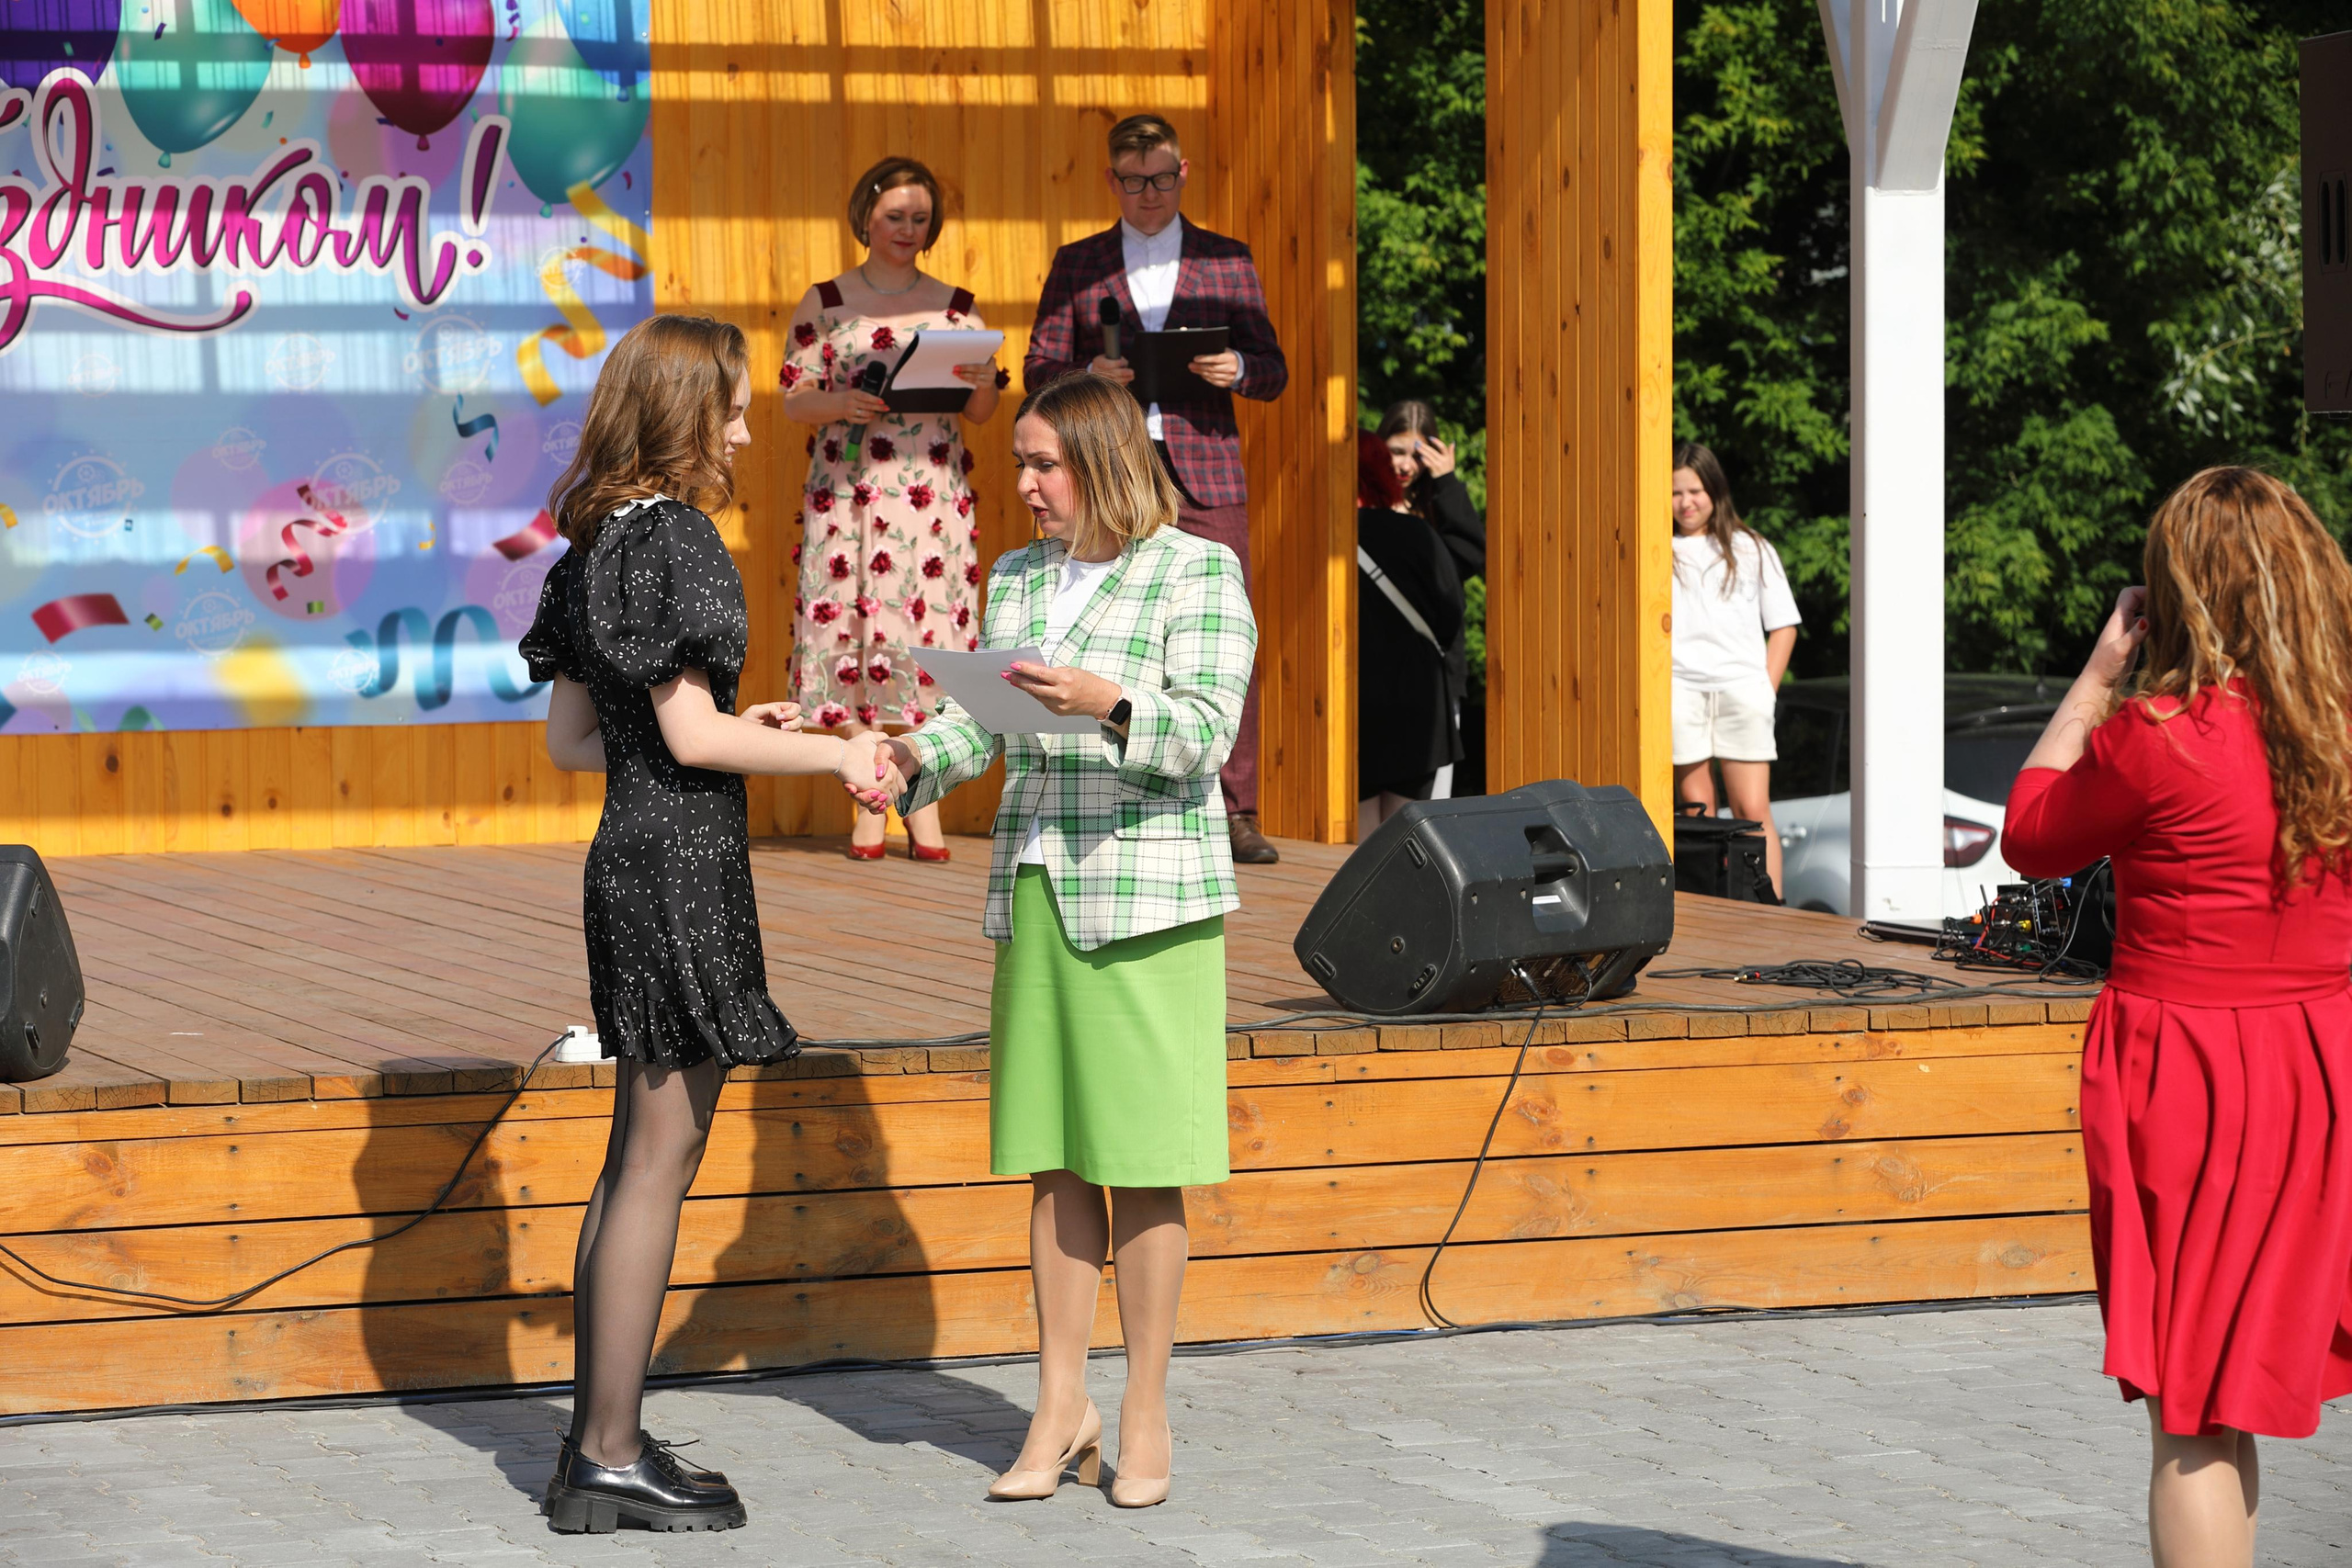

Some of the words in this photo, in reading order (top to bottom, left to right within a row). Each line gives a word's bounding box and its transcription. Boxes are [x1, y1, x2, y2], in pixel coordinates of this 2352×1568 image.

[403, 335, 503, 374] ОКТЯБРЬ
[42, 478, 145, 515] ОКТЯБРЬ
[175, 608, 255, 640] ОКТЯБРЬ
